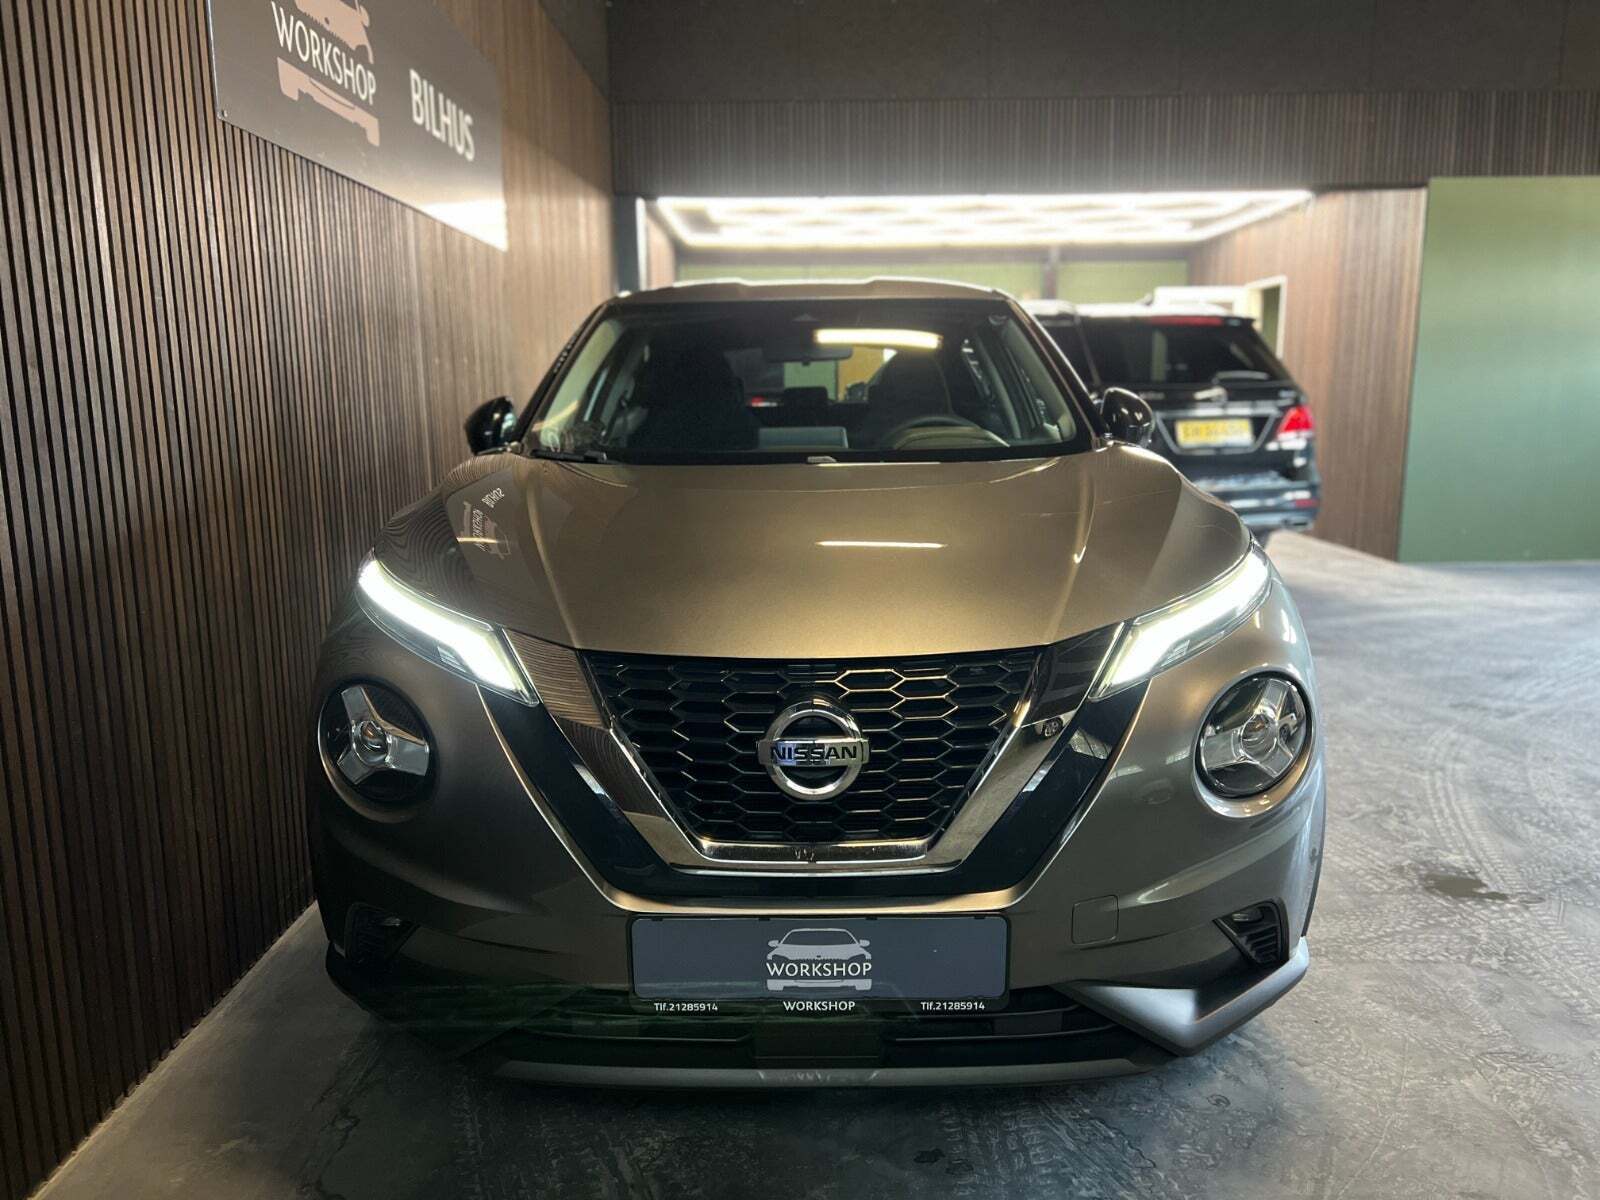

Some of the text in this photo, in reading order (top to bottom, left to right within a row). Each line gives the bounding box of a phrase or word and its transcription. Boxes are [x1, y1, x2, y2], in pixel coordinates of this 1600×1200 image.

[271, 1, 376, 105] WORKSHOP
[410, 68, 475, 162] BILHUS
[770, 746, 857, 760] NISSAN
[766, 962, 872, 977] WORKSHOP
[654, 1002, 718, 1011] Tlf.21285914
[783, 1001, 856, 1011] WORKSHOP
[920, 1001, 985, 1011] Tlf.21285914
